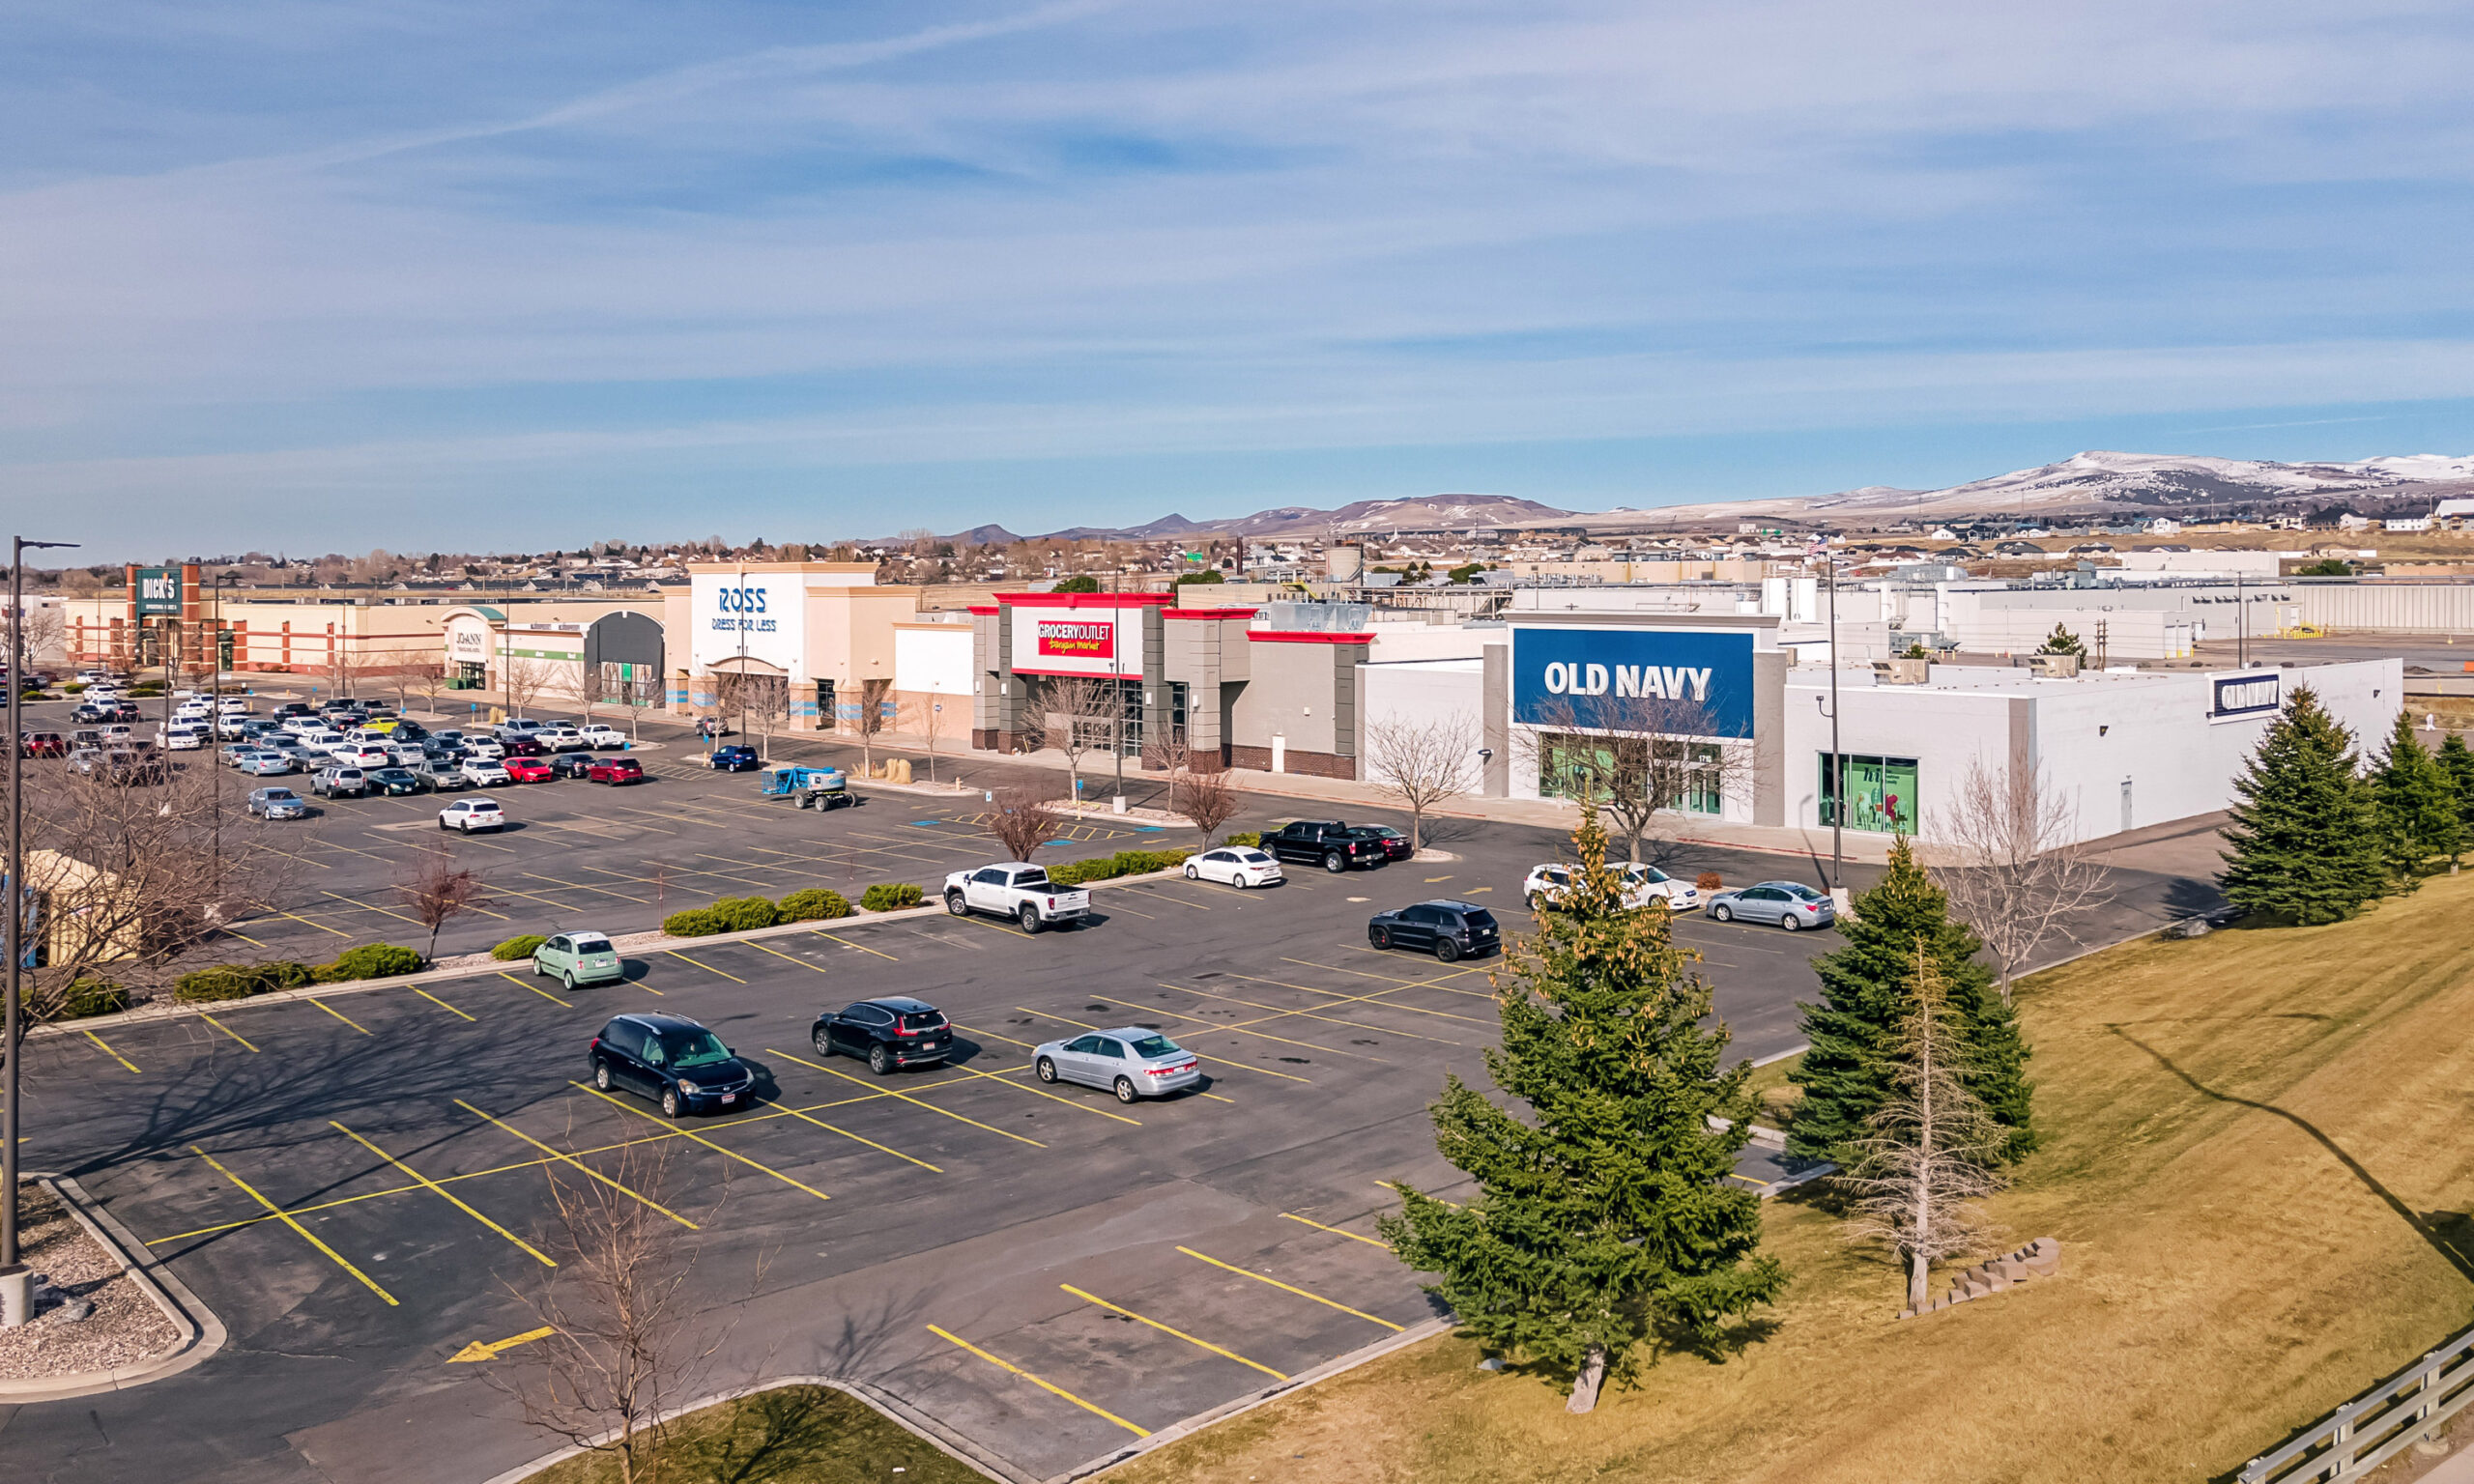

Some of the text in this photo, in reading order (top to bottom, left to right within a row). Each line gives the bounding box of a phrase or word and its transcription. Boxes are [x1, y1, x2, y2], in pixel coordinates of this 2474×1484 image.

[143, 578, 175, 599] DICK'S
[719, 587, 766, 613] ROSS
[711, 618, 776, 632] DRESS FOR LESS
[1544, 661, 1712, 702] OLD NAVY
[2221, 679, 2278, 710] OLD NAVY
